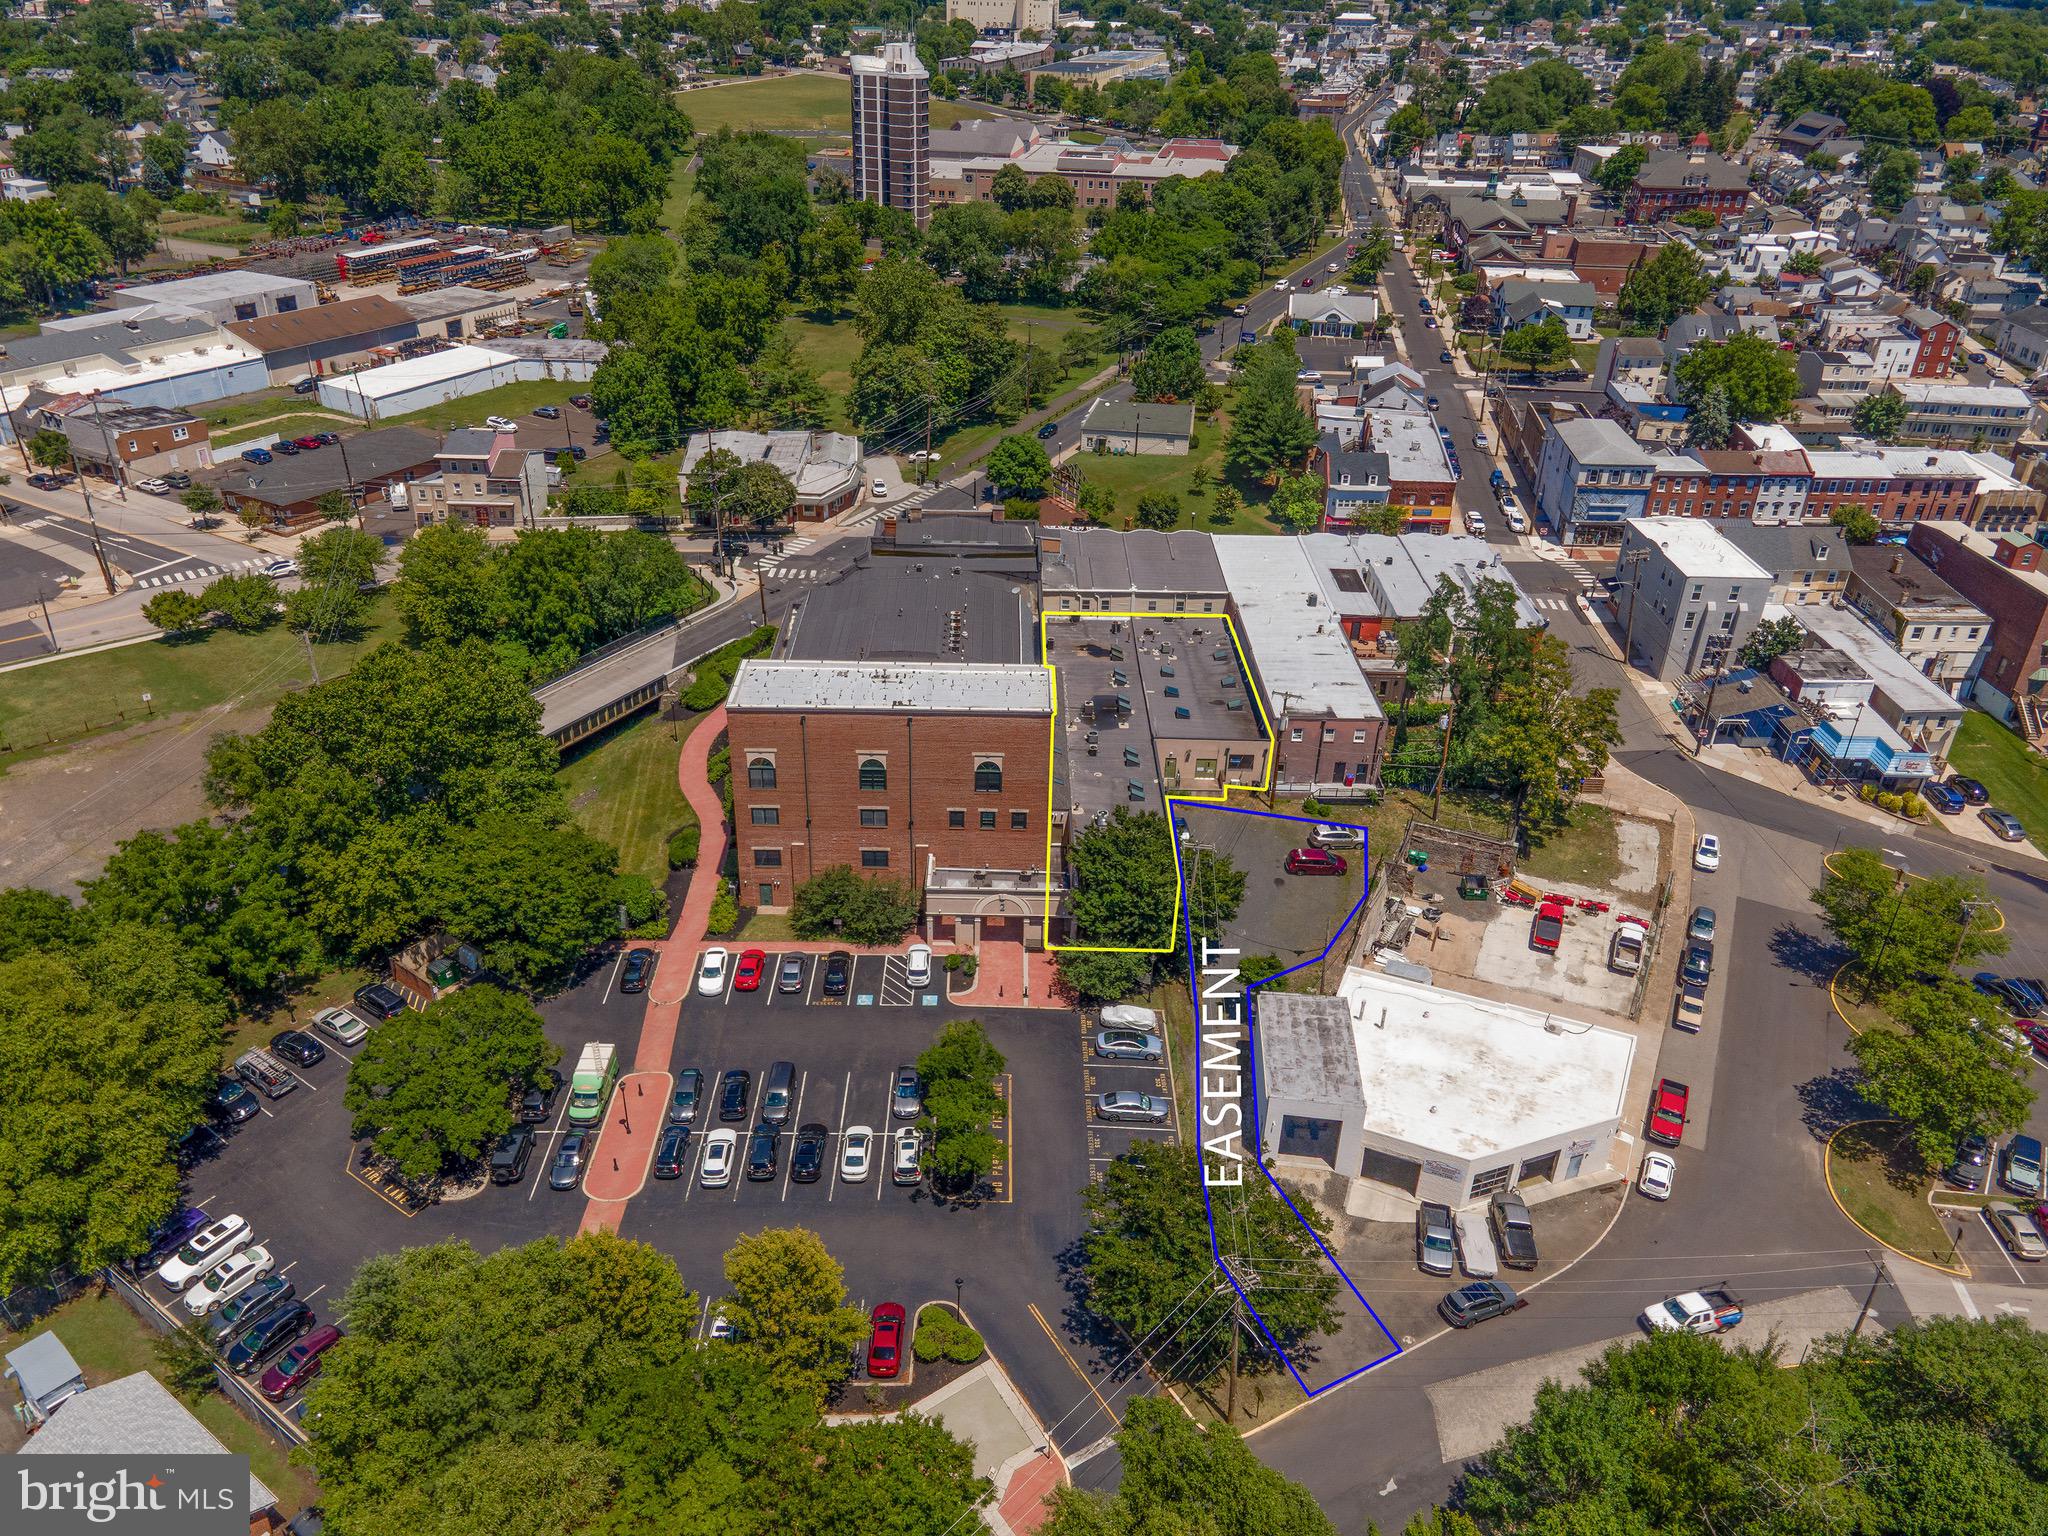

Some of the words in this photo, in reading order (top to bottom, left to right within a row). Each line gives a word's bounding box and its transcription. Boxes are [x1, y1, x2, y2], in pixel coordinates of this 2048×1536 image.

[360, 1166, 383, 1185] FIRE
[384, 1184, 408, 1205] LANE
[992, 1181, 1003, 1193] NO
